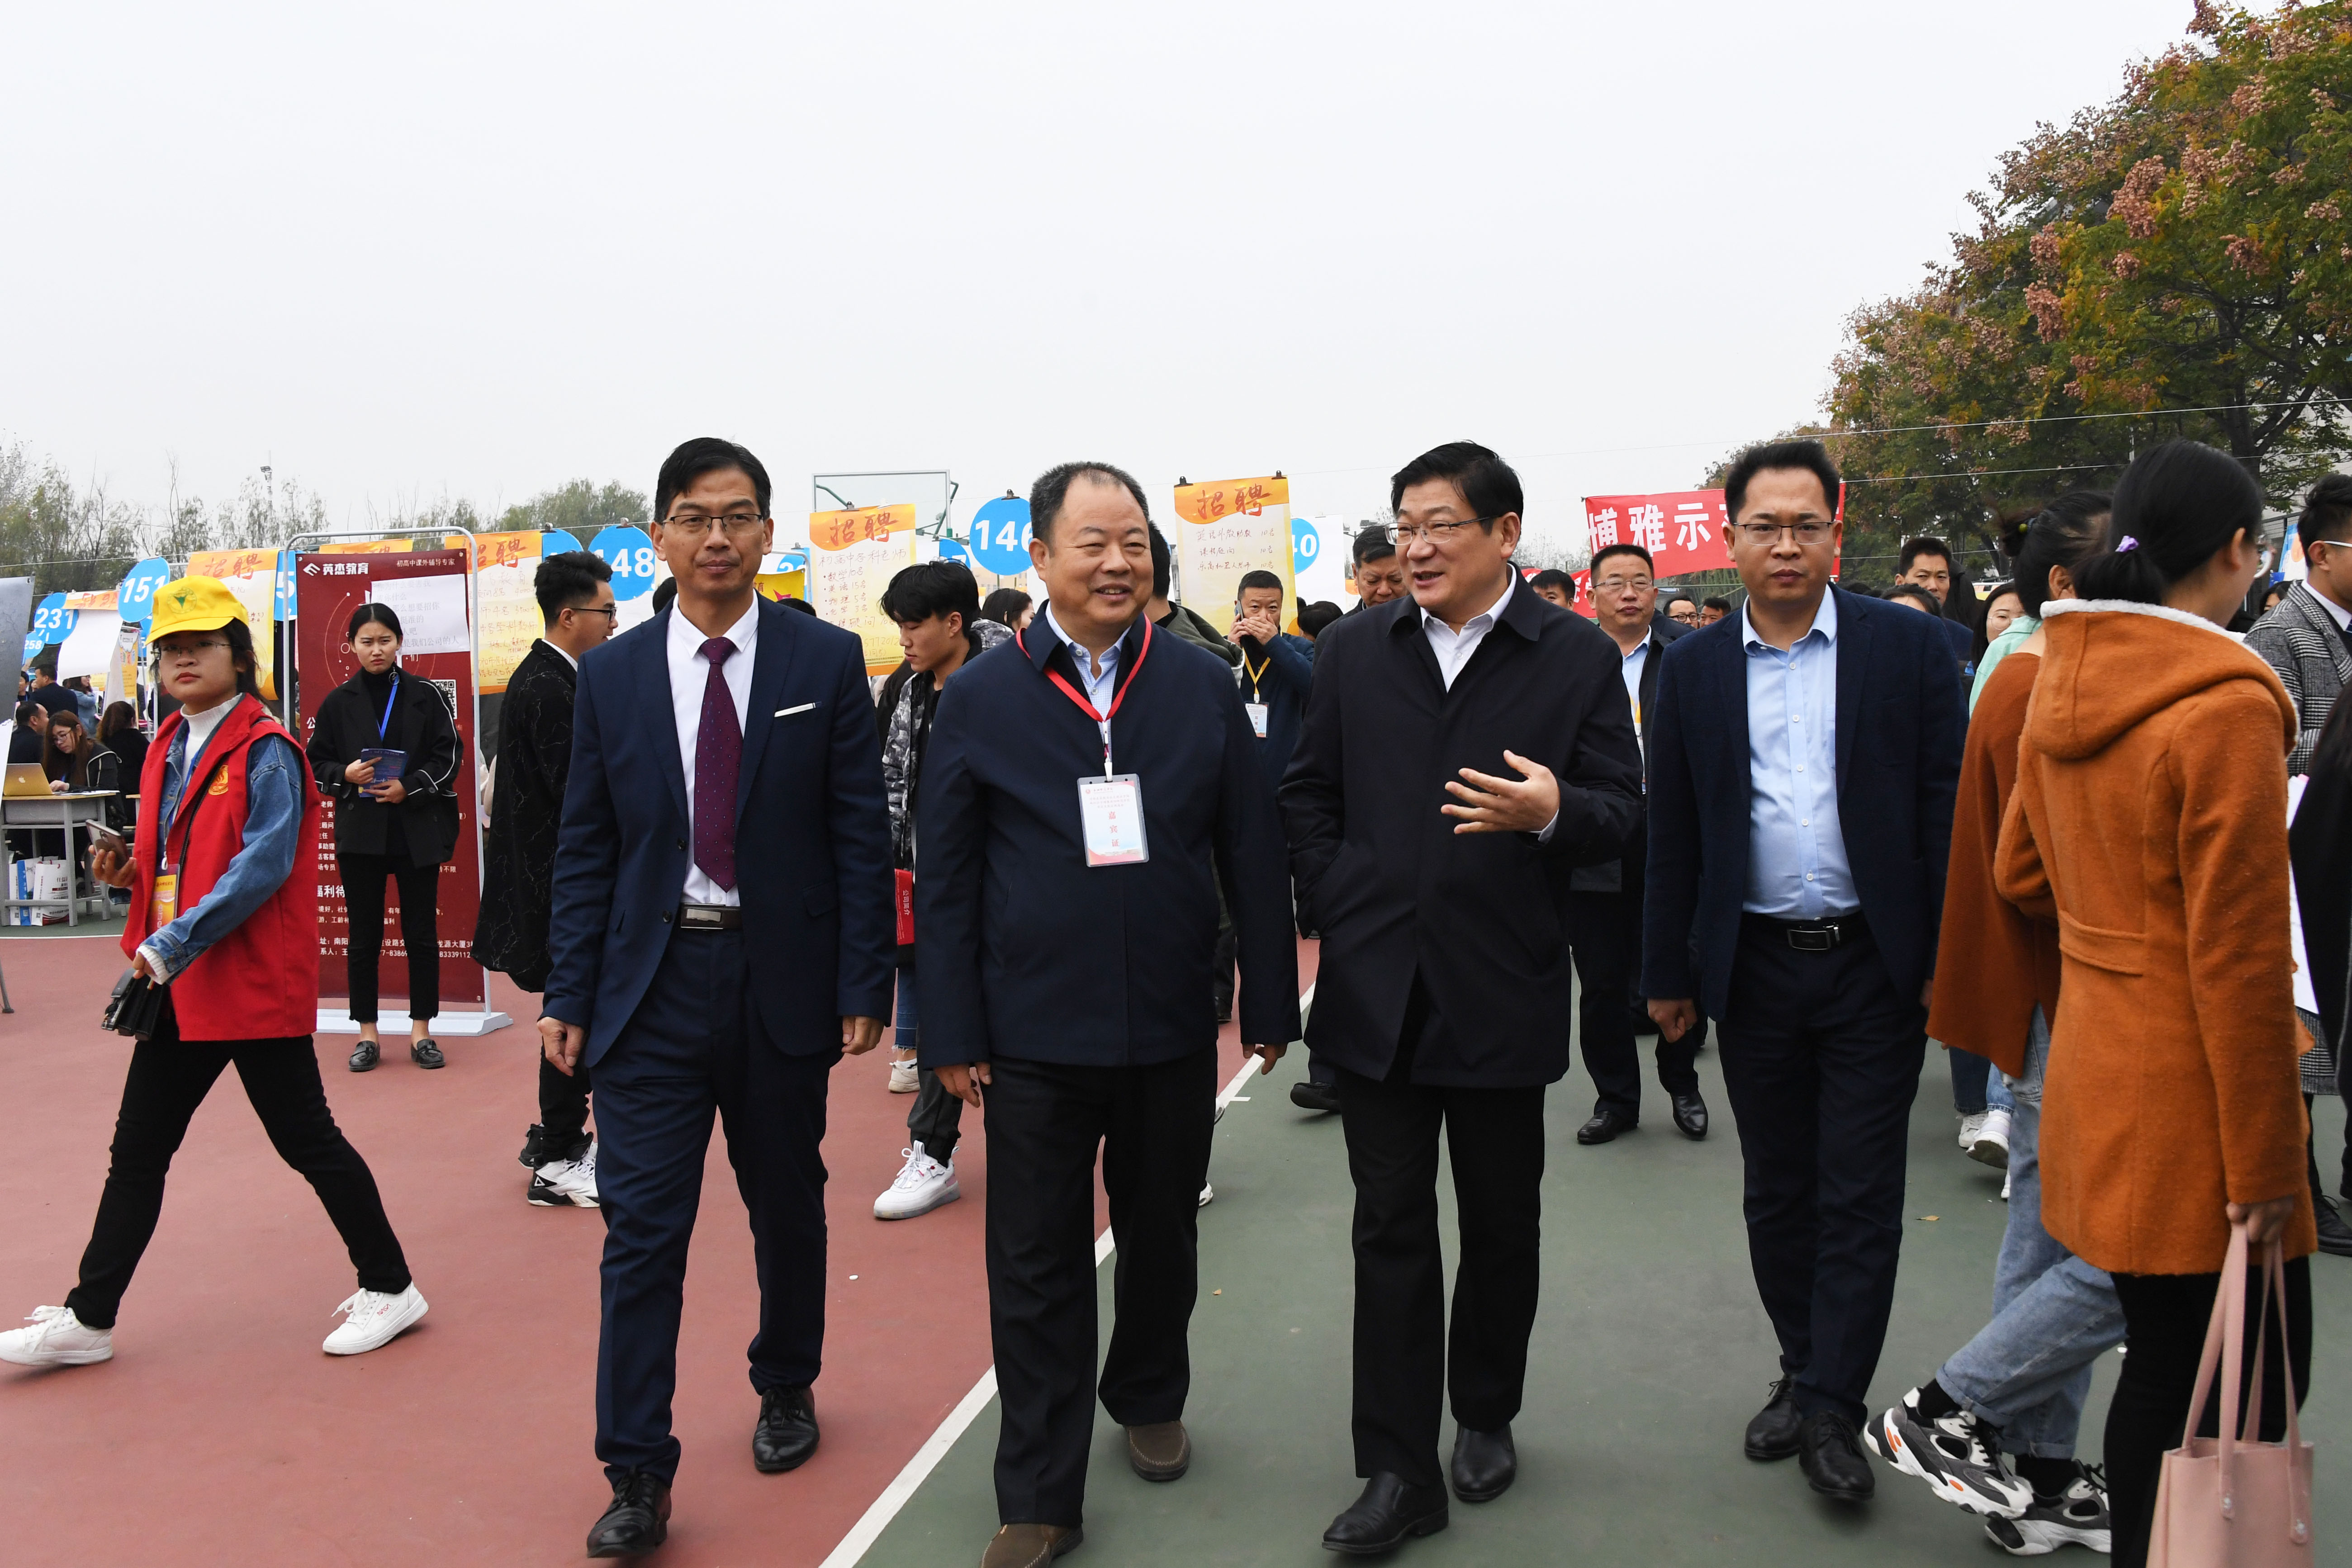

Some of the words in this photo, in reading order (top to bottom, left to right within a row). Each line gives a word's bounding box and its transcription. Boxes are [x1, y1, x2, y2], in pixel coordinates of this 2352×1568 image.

[1196, 483, 1272, 520] 招聘
[830, 510, 899, 546] 招聘
[396, 559, 455, 567] 初高中课外辅导专家
[467, 538, 527, 570] 招聘
[203, 553, 263, 580] 招聘
[322, 563, 369, 575] 英杰教育
[34, 608, 74, 629] 231
[24, 640, 42, 650] 258
[377, 1303, 391, 1316] NASA
